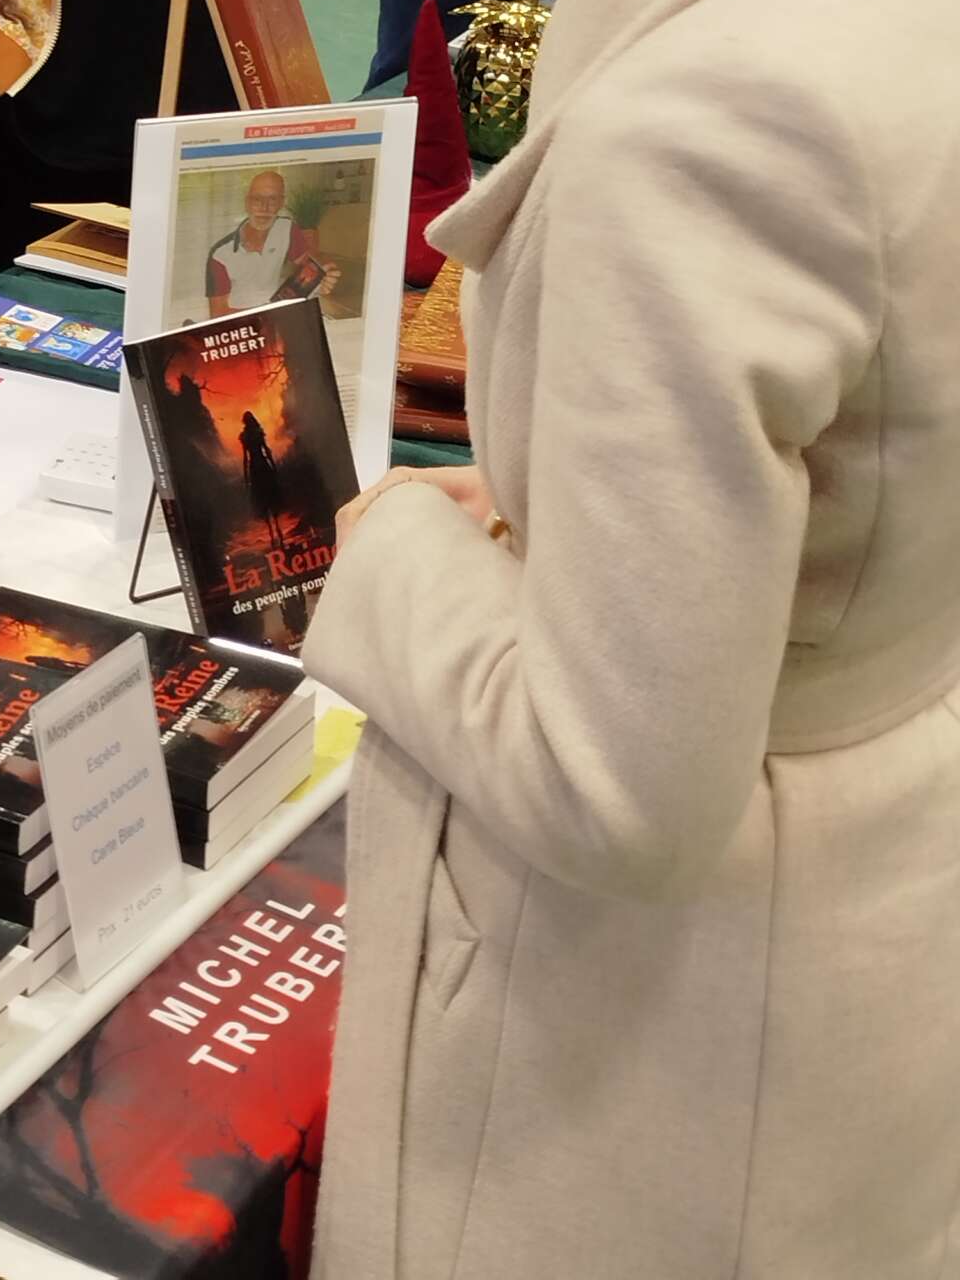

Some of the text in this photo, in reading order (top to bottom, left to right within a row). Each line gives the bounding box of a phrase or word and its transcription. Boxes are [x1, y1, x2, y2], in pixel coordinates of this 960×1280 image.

[200, 336, 266, 363] TRUBERT
[204, 325, 258, 347] MICHEL
[224, 562, 262, 595] La
[232, 584, 299, 615] des peuples
[154, 659, 220, 712] Reine
[171, 666, 239, 732] peuples sombres
[149, 899, 315, 1036] MICHEL
